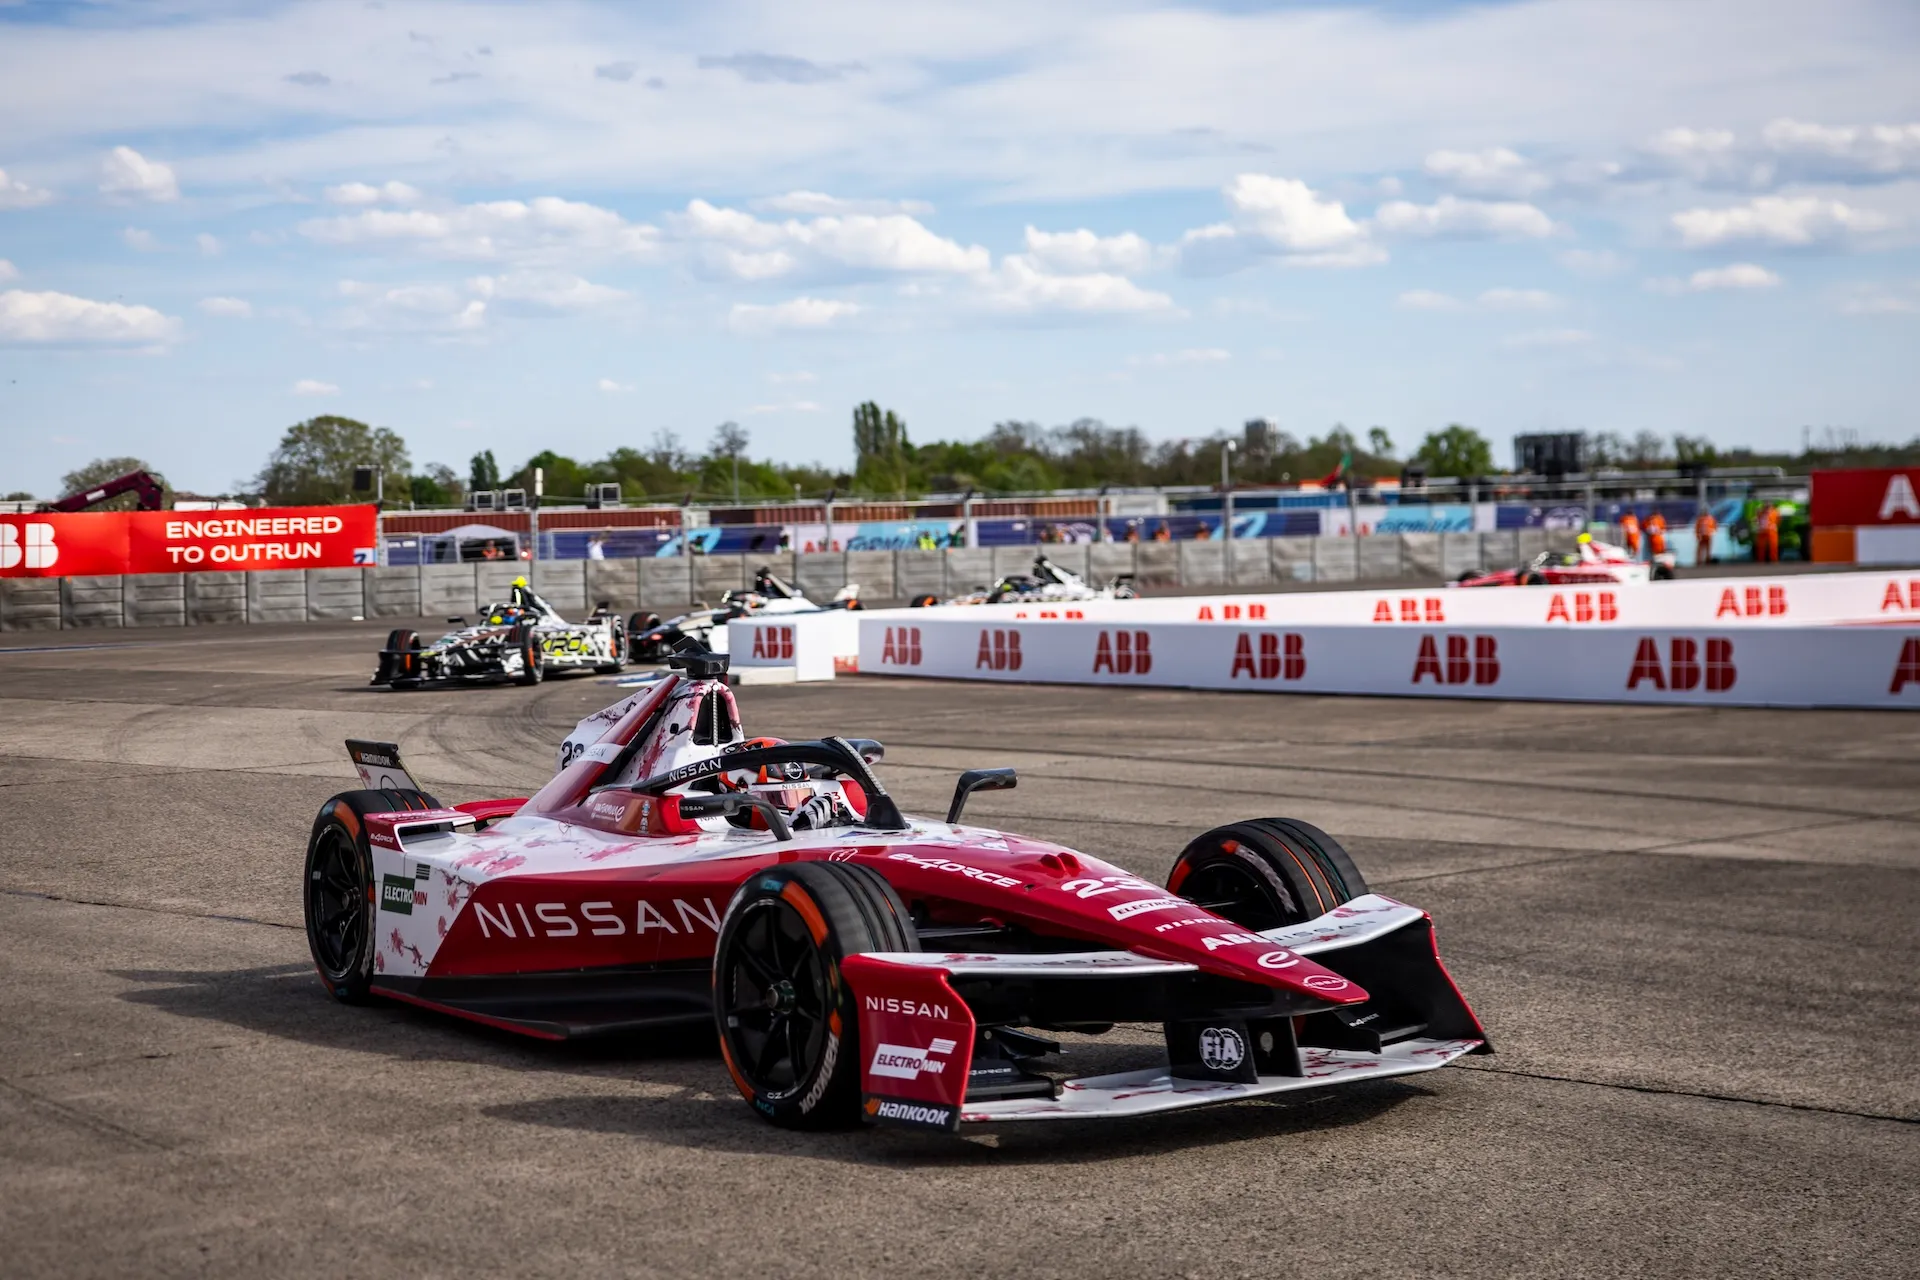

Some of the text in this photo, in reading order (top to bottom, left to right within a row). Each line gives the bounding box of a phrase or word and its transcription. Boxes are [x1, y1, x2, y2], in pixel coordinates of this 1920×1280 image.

[166, 516, 343, 539] ENGINEERED
[166, 542, 322, 564] TO OUTRUN
[1373, 599, 1446, 622] ABB
[1545, 592, 1619, 624] ABB
[1717, 585, 1789, 617] ABB
[752, 626, 794, 659] ABB
[882, 627, 923, 665] ABB
[976, 629, 1023, 671] ABB
[1093, 631, 1152, 674] ABB
[1231, 632, 1307, 680] ABB
[1411, 634, 1501, 686] ABB
[1626, 636, 1738, 692] ABB
[668, 758, 722, 783] NISSAN
[1061, 876, 1157, 899] 23
[474, 897, 723, 939] NISSAN
[866, 995, 948, 1020] NISSAN
[877, 1053, 946, 1075] ELECTROMIN
